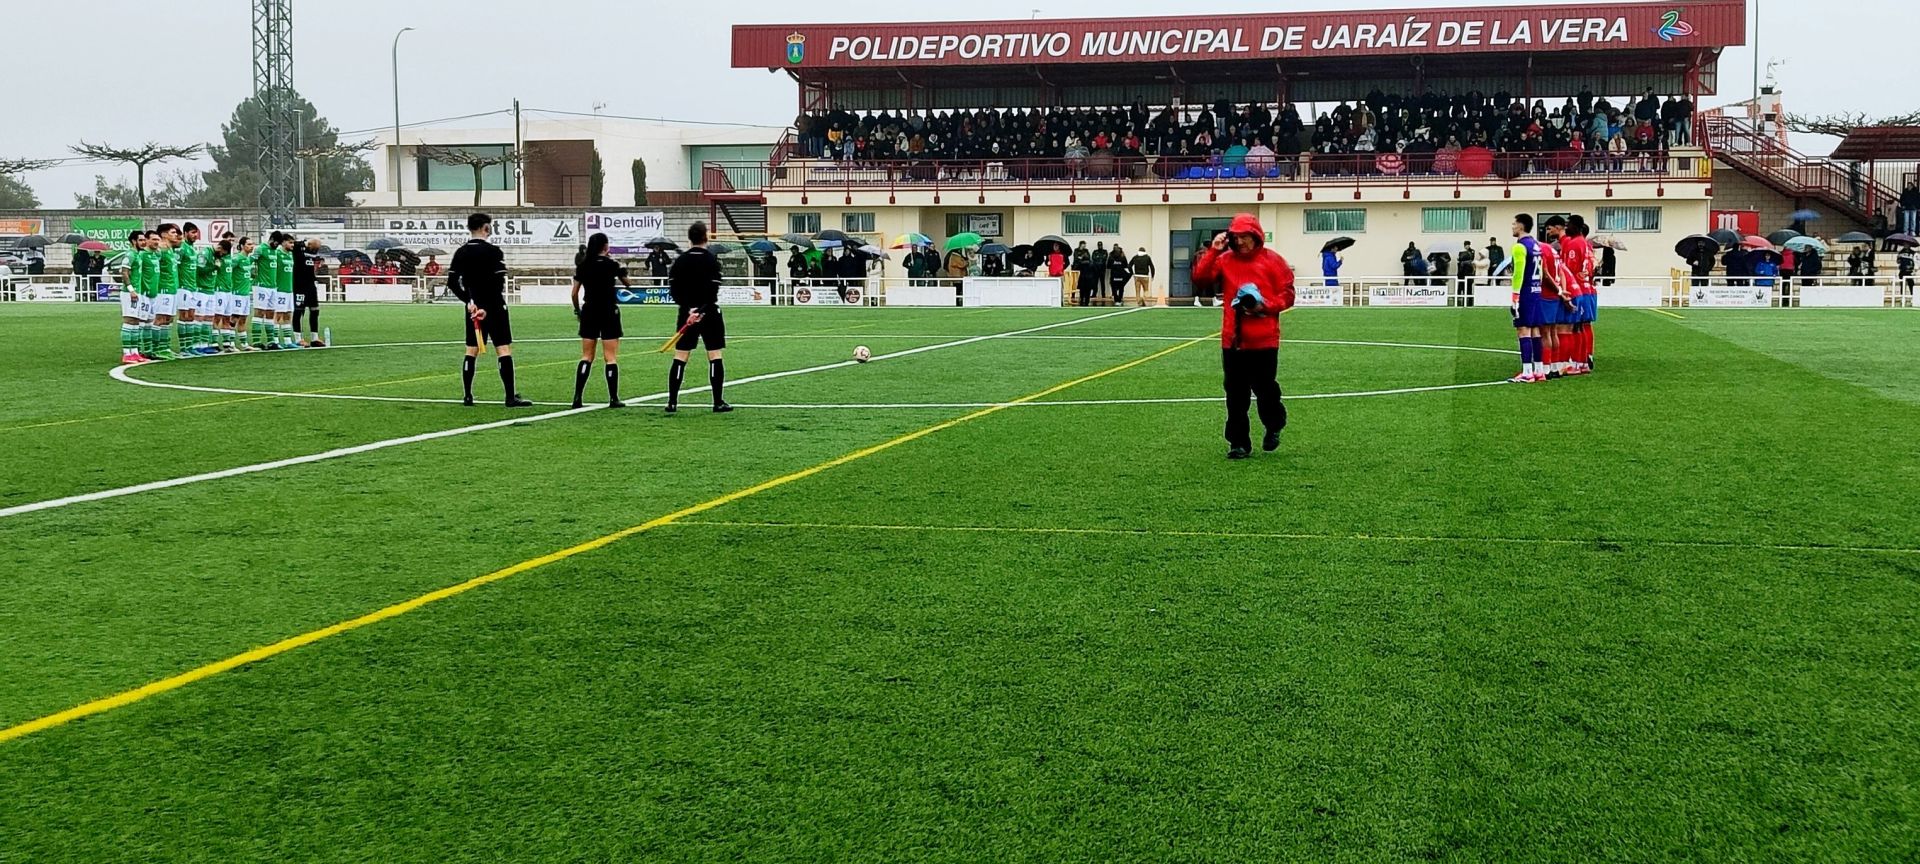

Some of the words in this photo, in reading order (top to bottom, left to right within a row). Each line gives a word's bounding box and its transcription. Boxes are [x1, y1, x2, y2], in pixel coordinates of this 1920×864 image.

[829, 32, 1071, 60] POLIDEPORTIVO
[1080, 28, 1250, 56] MUNICIPAL
[1260, 26, 1306, 51] DE
[1312, 16, 1431, 49] JARAÍZ
[1436, 21, 1485, 46] DE
[1489, 20, 1533, 45] LA
[1540, 17, 1629, 43] VERA
[389, 220, 428, 235] R&A
[505, 220, 533, 235] S.L
[604, 215, 662, 230] Dentality
[87, 229, 110, 239] CASA
[111, 229, 123, 239] DE
